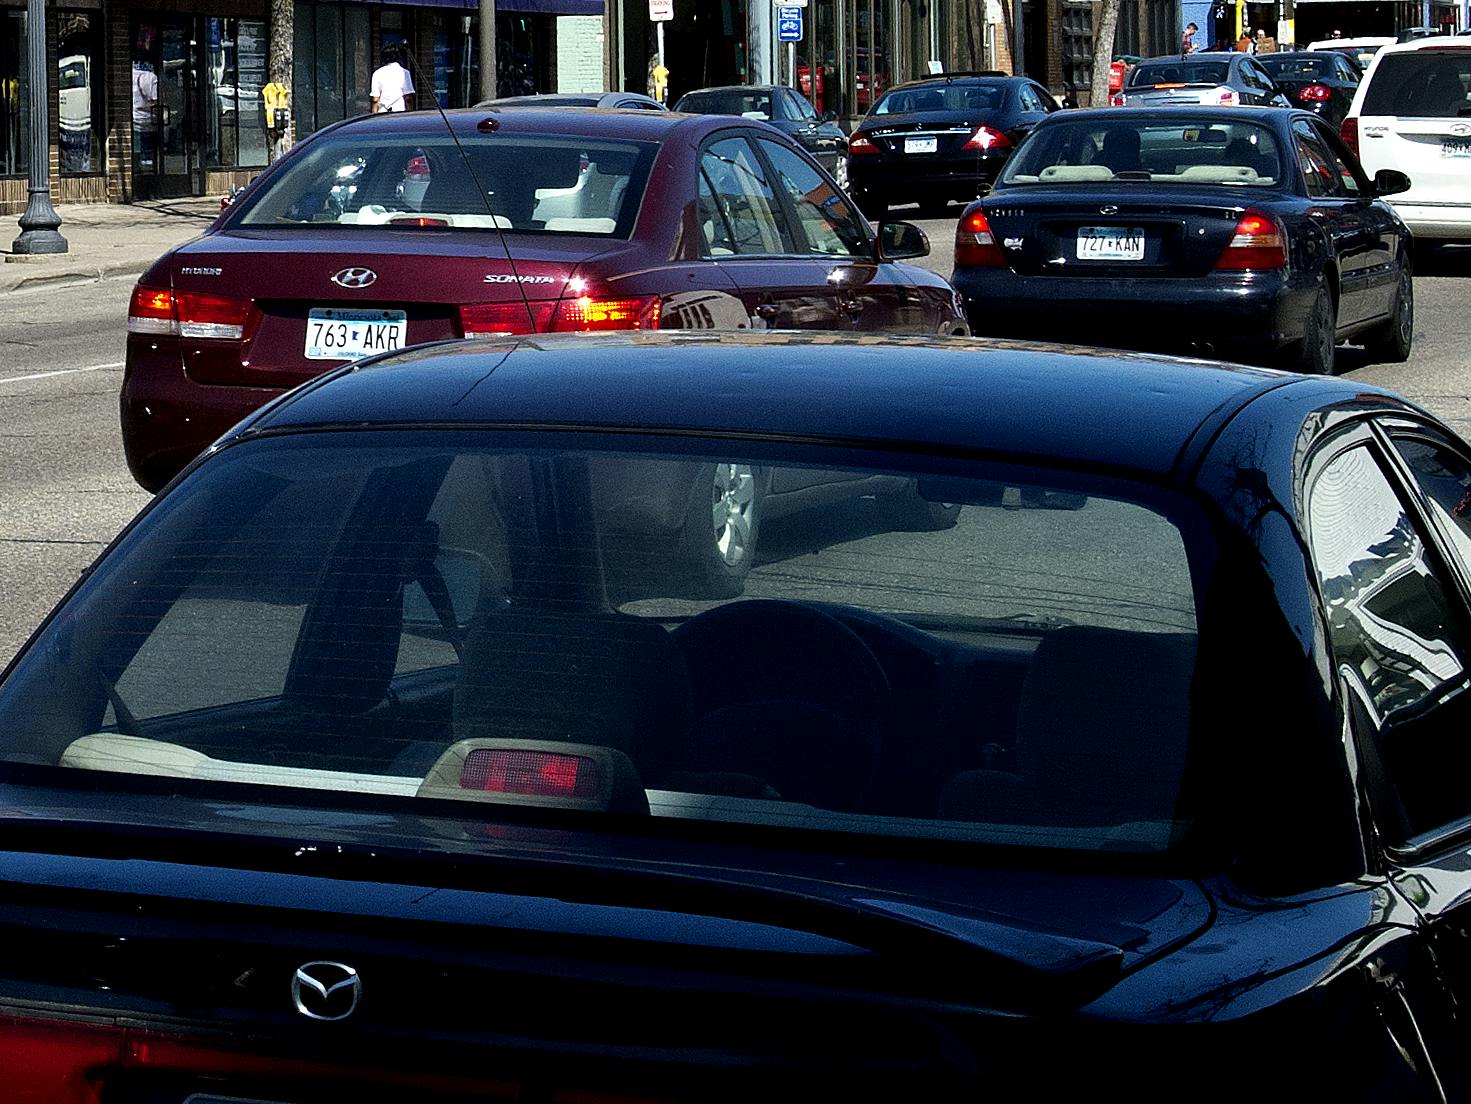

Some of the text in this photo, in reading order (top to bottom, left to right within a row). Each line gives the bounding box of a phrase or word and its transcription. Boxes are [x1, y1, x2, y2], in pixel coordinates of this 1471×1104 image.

[1081, 236, 1140, 252] 727 KAN
[484, 274, 555, 284] SONATA
[313, 323, 400, 351] 763 AKR
